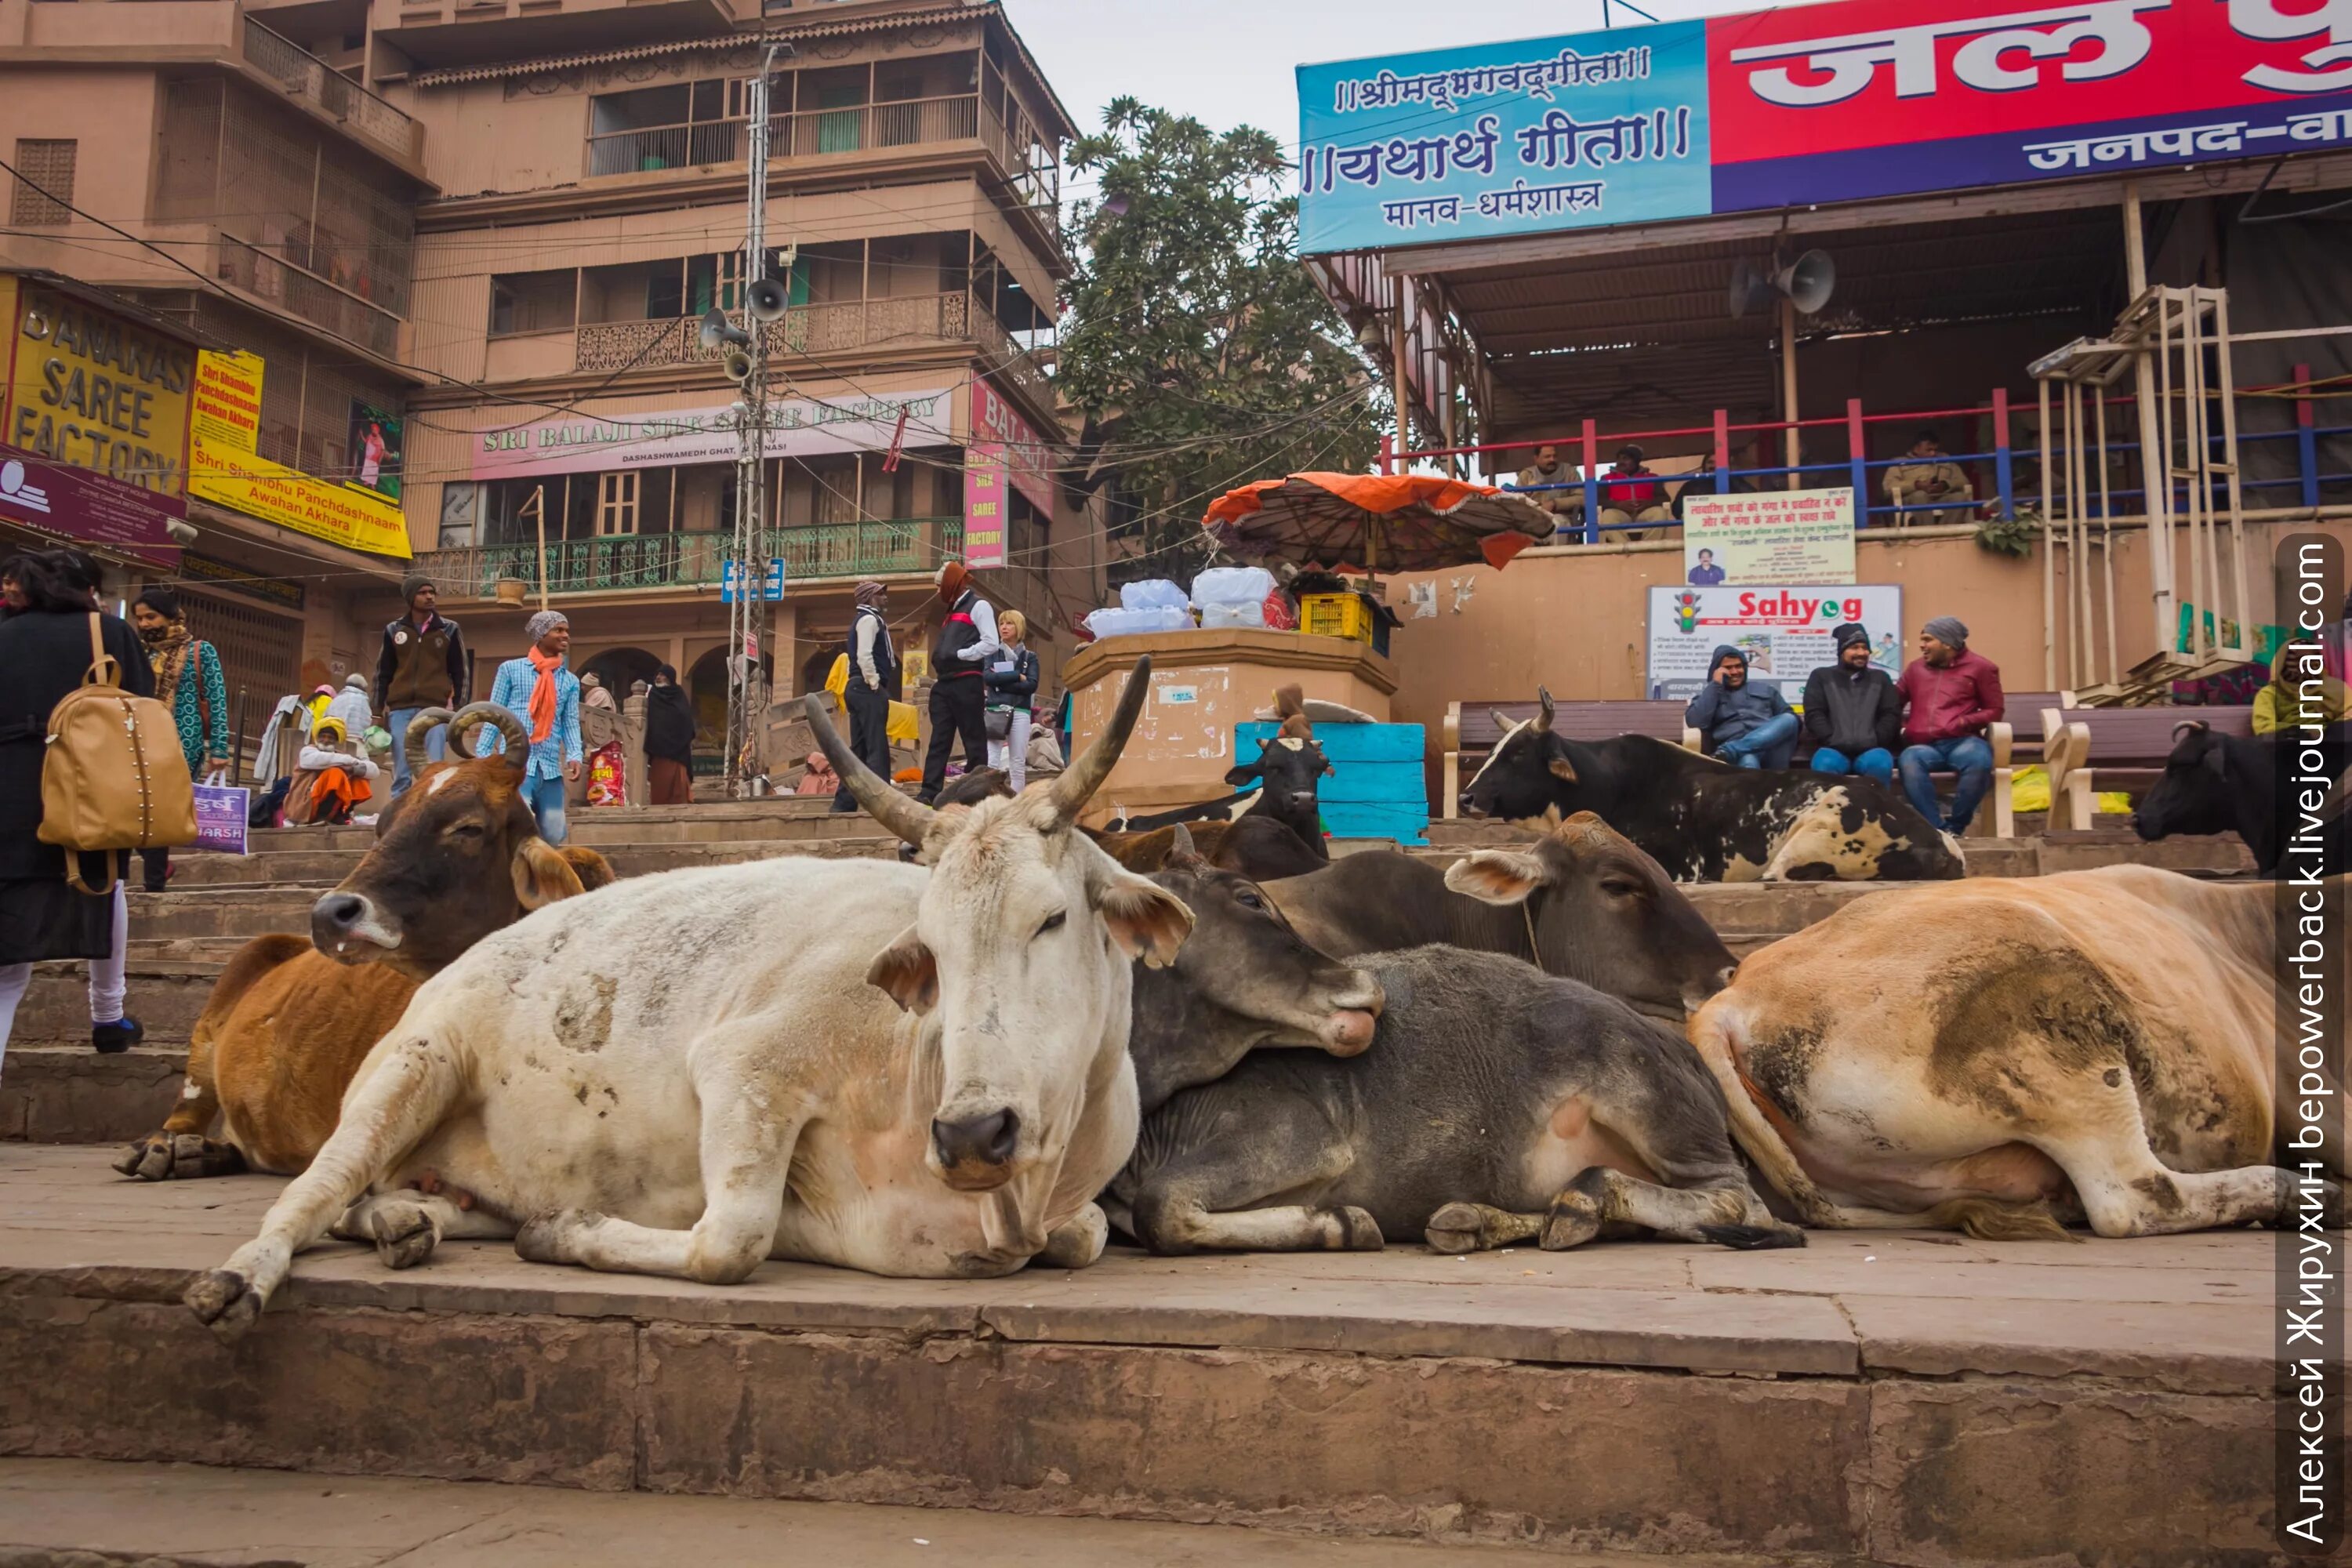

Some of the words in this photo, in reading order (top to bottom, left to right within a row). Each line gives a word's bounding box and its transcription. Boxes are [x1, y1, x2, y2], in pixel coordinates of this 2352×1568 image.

[1730, 0, 2172, 107] जल
[22, 293, 191, 395] BANARAS
[41, 358, 154, 438] SAREE
[195, 379, 260, 415] Panchdashnaam
[202, 364, 219, 382] Shri
[220, 372, 256, 397] Shambhu
[196, 397, 227, 419] Awahan
[228, 410, 255, 430] Akhara
[483, 430, 529, 452] SRI
[538, 422, 633, 448] BALAJI
[641, 415, 706, 439] SILK
[812, 396, 940, 425] FACTORY
[14, 405, 177, 495] FACTORY
[622, 448, 707, 463] DASHASHWAMEDH
[195, 450, 224, 470] Shri
[228, 463, 292, 495] Shambhu
[296, 487, 401, 532] Panchdashnaam
[975, 474, 994, 488] SILK
[249, 486, 303, 515] Awahan
[305, 506, 350, 532] Akhara
[972, 501, 996, 517] SAREE
[967, 529, 1002, 546] FACTORY
